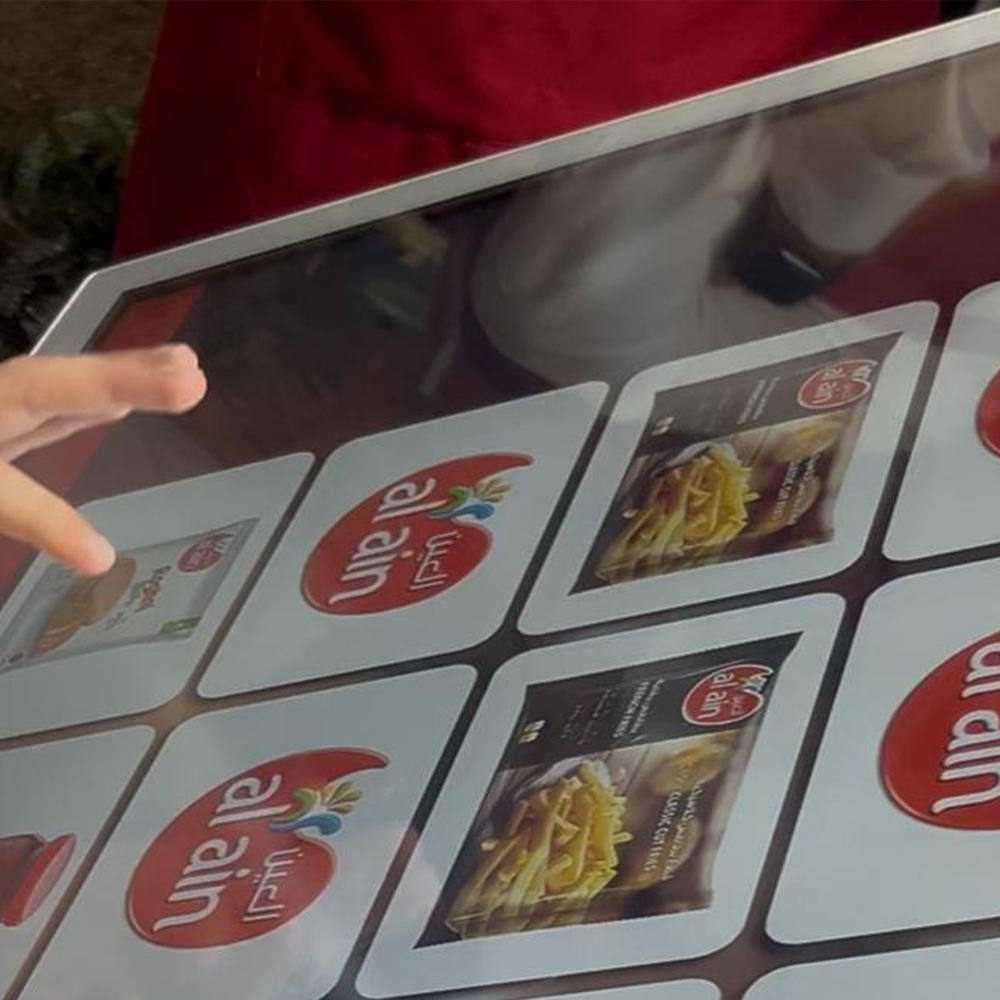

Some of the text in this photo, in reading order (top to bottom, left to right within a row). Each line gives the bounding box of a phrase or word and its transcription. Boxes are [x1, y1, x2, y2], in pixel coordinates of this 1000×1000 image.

[330, 478, 446, 603] al ain
[410, 530, 460, 590] العين
[698, 673, 740, 719] al ain
[154, 774, 290, 931] al ain
[243, 848, 304, 922] العين
